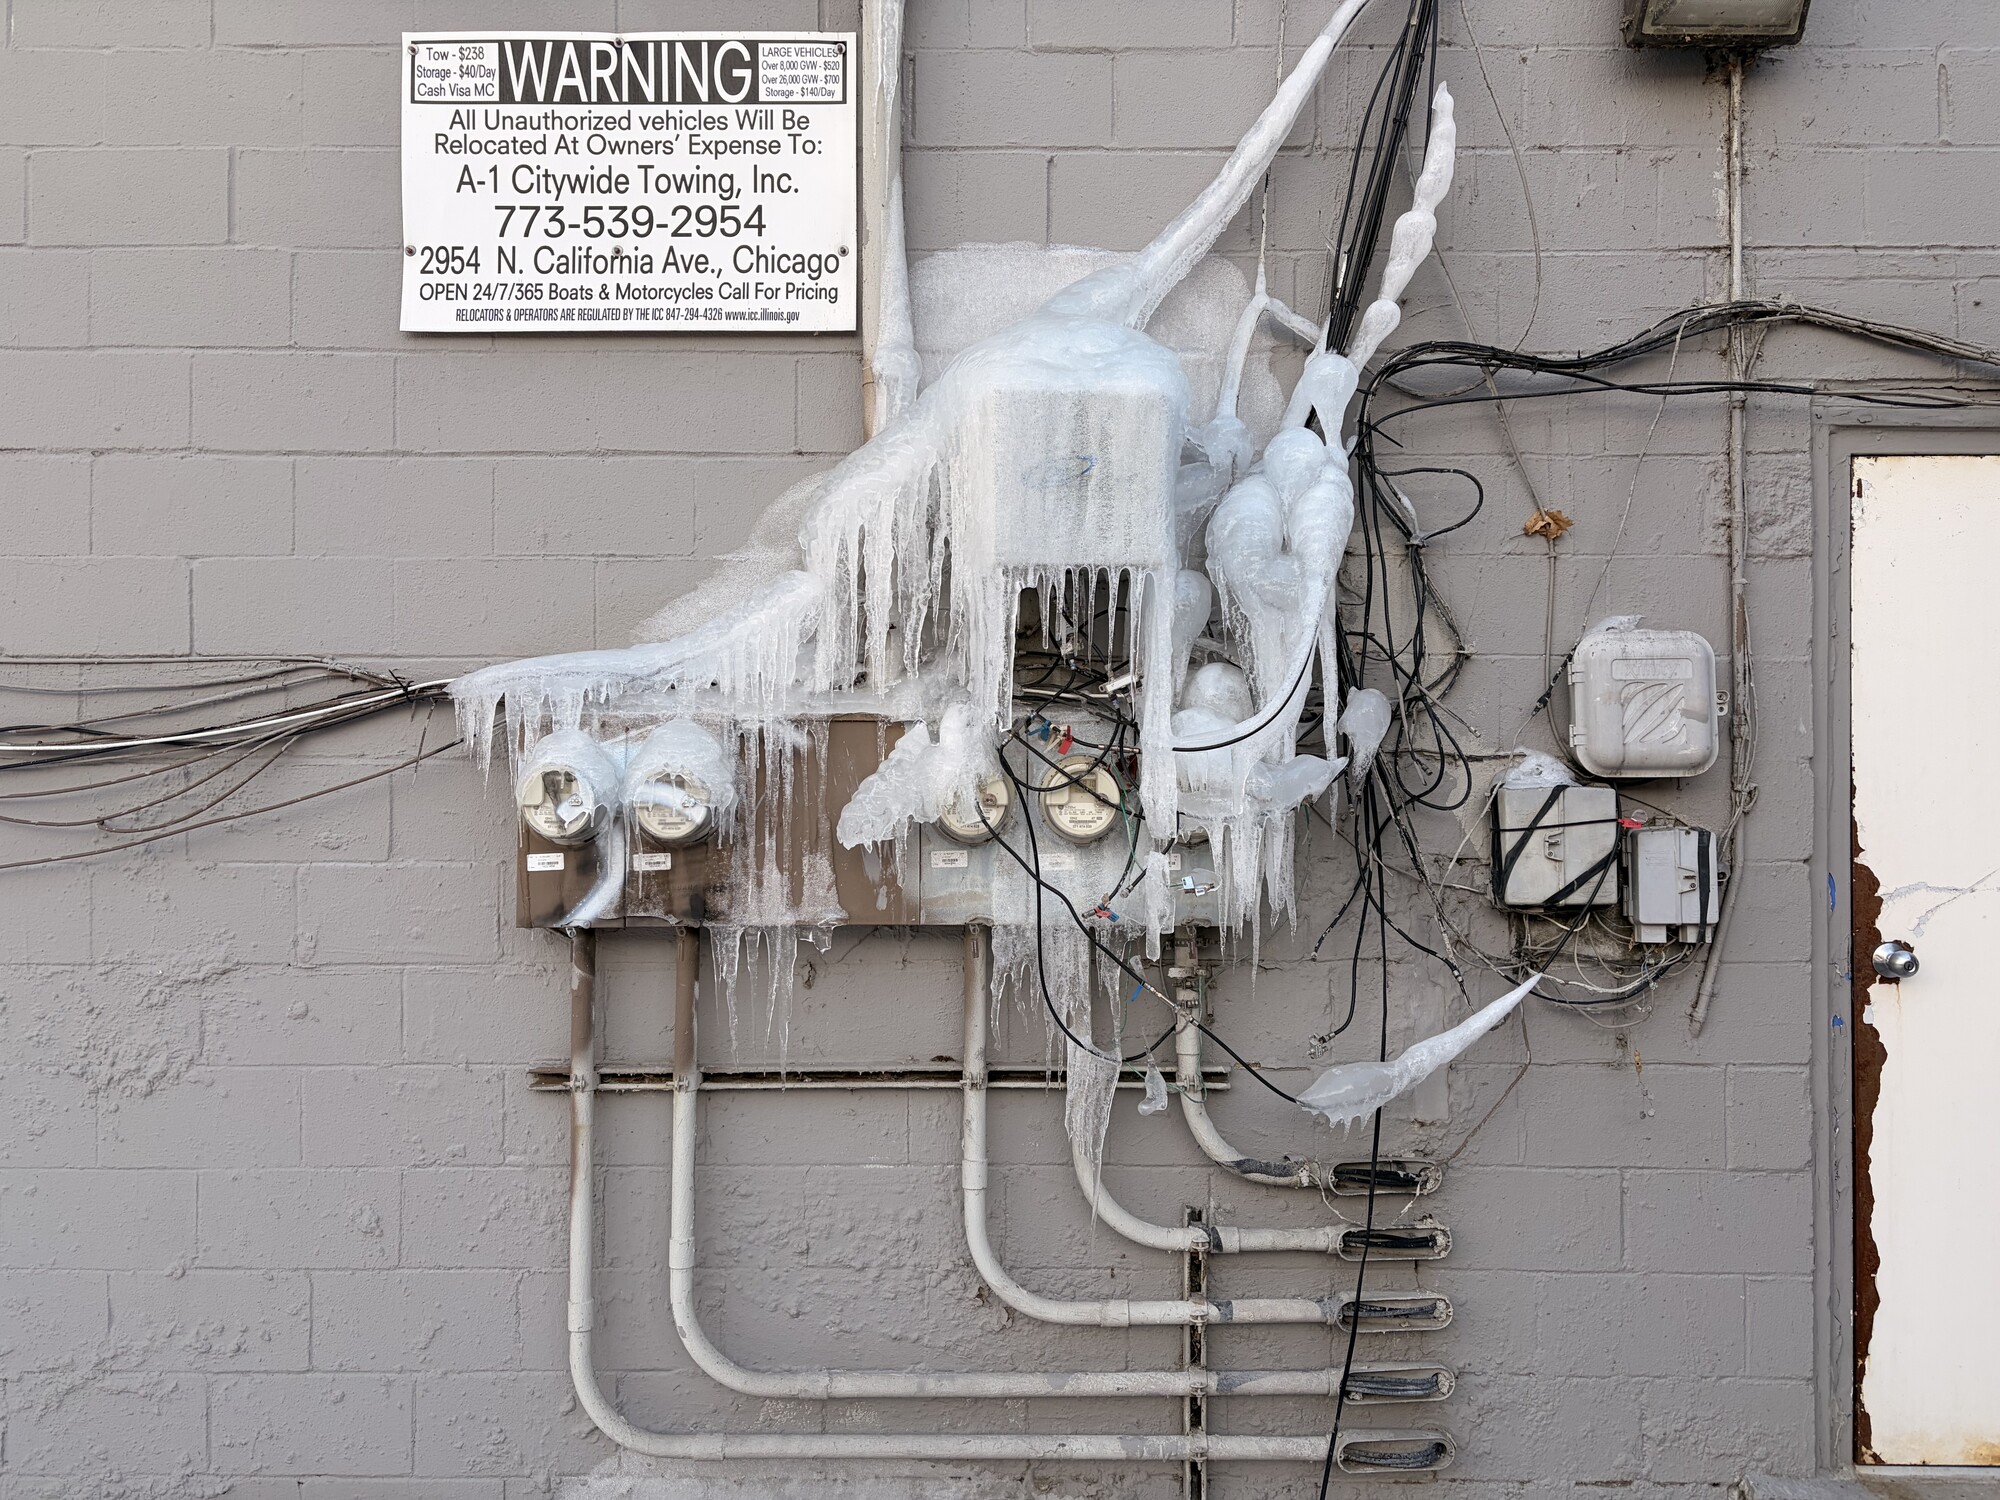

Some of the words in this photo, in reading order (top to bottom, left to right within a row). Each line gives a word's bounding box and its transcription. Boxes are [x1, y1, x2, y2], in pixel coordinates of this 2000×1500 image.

[426, 48, 449, 60] Tow
[459, 46, 484, 61] $238
[763, 47, 791, 57] LARGE
[794, 46, 839, 57] VEHICLES
[417, 65, 451, 81] Storage
[459, 64, 496, 80] $40/Day
[504, 41, 752, 103] WARNING
[762, 61, 778, 70] Over
[780, 61, 798, 71] 8,000
[800, 61, 817, 70] GVW
[824, 61, 839, 71] $520
[762, 75, 777, 84] Over
[779, 75, 800, 85] 26,000
[802, 75, 818, 84] GVW
[824, 75, 839, 84] $700
[418, 83, 445, 96] Cash
[449, 83, 470, 96] Visa
[475, 83, 494, 96] MC
[766, 87, 794, 98] Storage
[801, 87, 835, 98] $140/Day
[449, 109, 475, 130] All
[485, 109, 631, 130] Unauthorized
[639, 110, 728, 130] vehicles
[735, 110, 773, 130] Will
[782, 109, 810, 130] Be
[435, 133, 546, 155] Relocated
[554, 134, 579, 155] At
[689, 134, 781, 160] Expense
[787, 134, 822, 155] To:
[456, 165, 497, 193] A-1
[512, 164, 629, 201] Citywide
[637, 165, 742, 201] Towing,
[753, 165, 799, 193] Inc.
[495, 205, 766, 238] 773-539-2954
[420, 246, 480, 274] 2954
[498, 246, 523, 274] N.
[534, 246, 653, 274] California
[662, 246, 722, 278] Ave.,
[733, 245, 840, 280] Chicago
[420, 283, 467, 300] OPEN
[473, 283, 543, 300] 24/7/365
[549, 283, 593, 300] Boats
[599, 284, 609, 300] &
[616, 282, 713, 304] Motorcycles
[719, 282, 749, 299] Call
[755, 282, 780, 299] For
[786, 282, 838, 304] Pricing
[456, 309, 504, 321] RELOCATORS
[506, 309, 511, 321] &
[514, 308, 558, 321] OPERATORS
[560, 308, 575, 321] ARE
[578, 308, 620, 321] REGULATED
[623, 308, 633, 320] BY
[636, 308, 650, 320] THE
[652, 308, 663, 320] ICC
[666, 308, 722, 320] 847-294-4326
[725, 308, 799, 324] www.icc.illinois.gov
